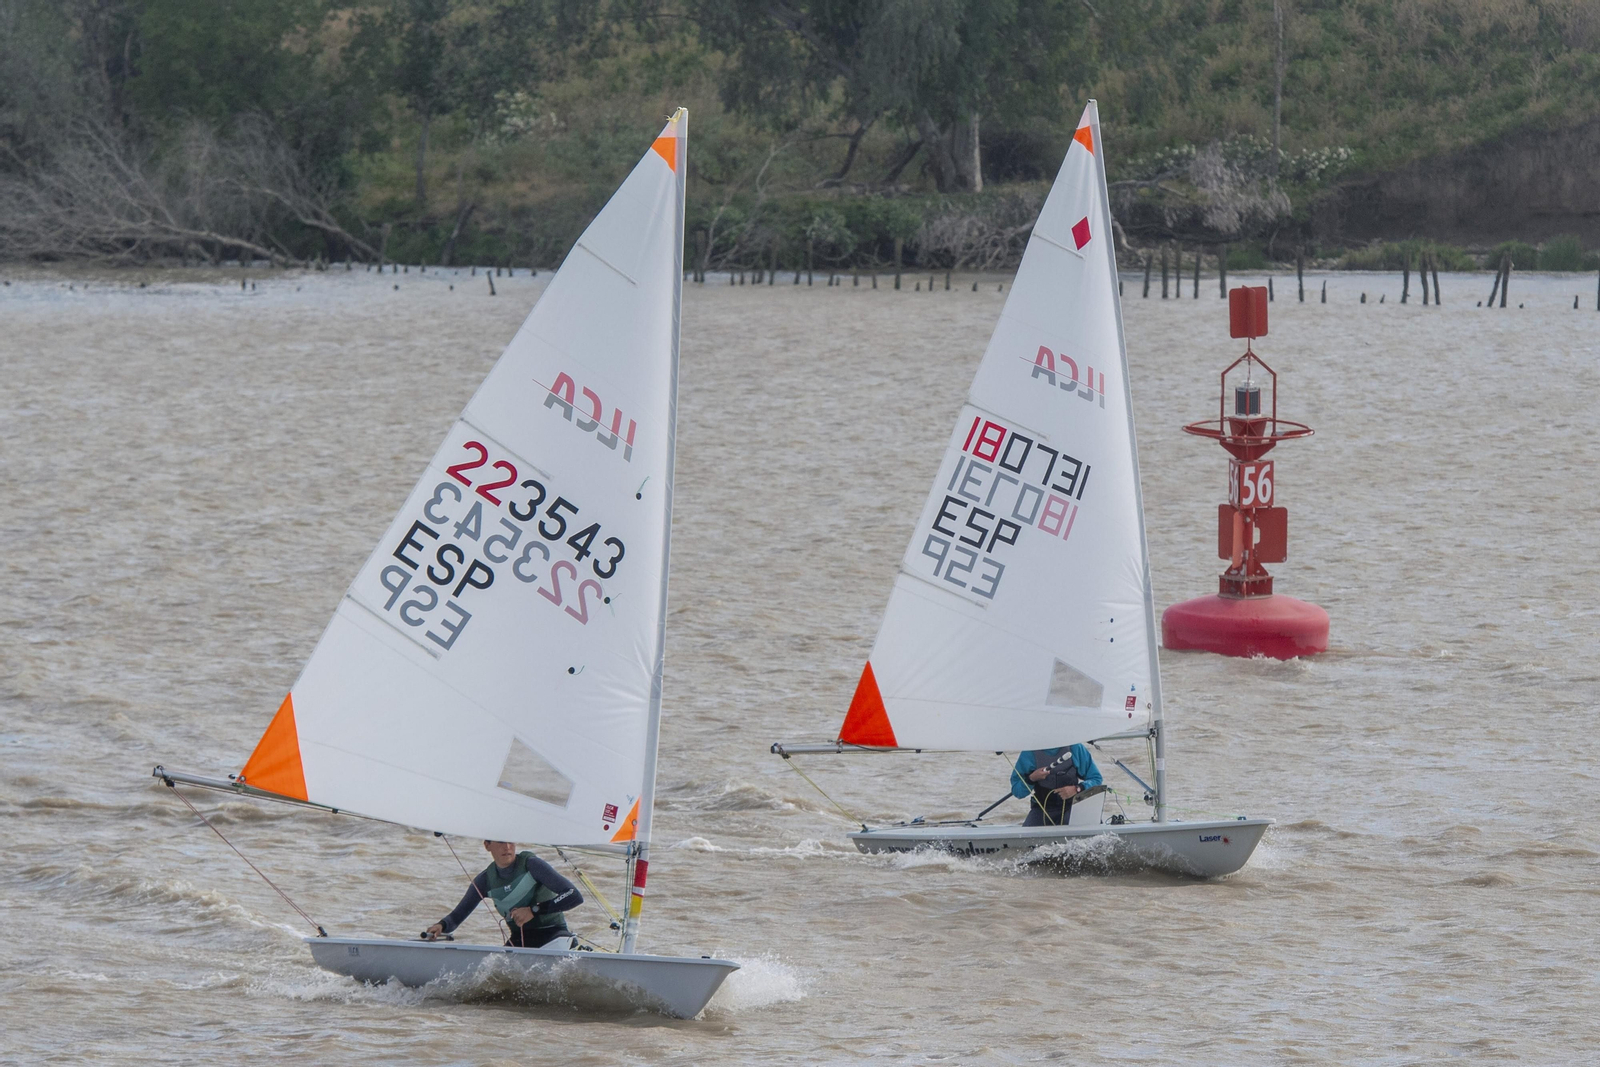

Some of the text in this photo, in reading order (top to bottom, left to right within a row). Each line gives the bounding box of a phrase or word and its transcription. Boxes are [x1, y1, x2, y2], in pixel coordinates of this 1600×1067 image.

[962, 416, 1091, 500] 180731
[1242, 464, 1272, 505] 56
[445, 441, 625, 579] 223543
[932, 494, 1022, 554] ESP
[392, 519, 494, 598] ESP
[1199, 835, 1221, 843] Laser
